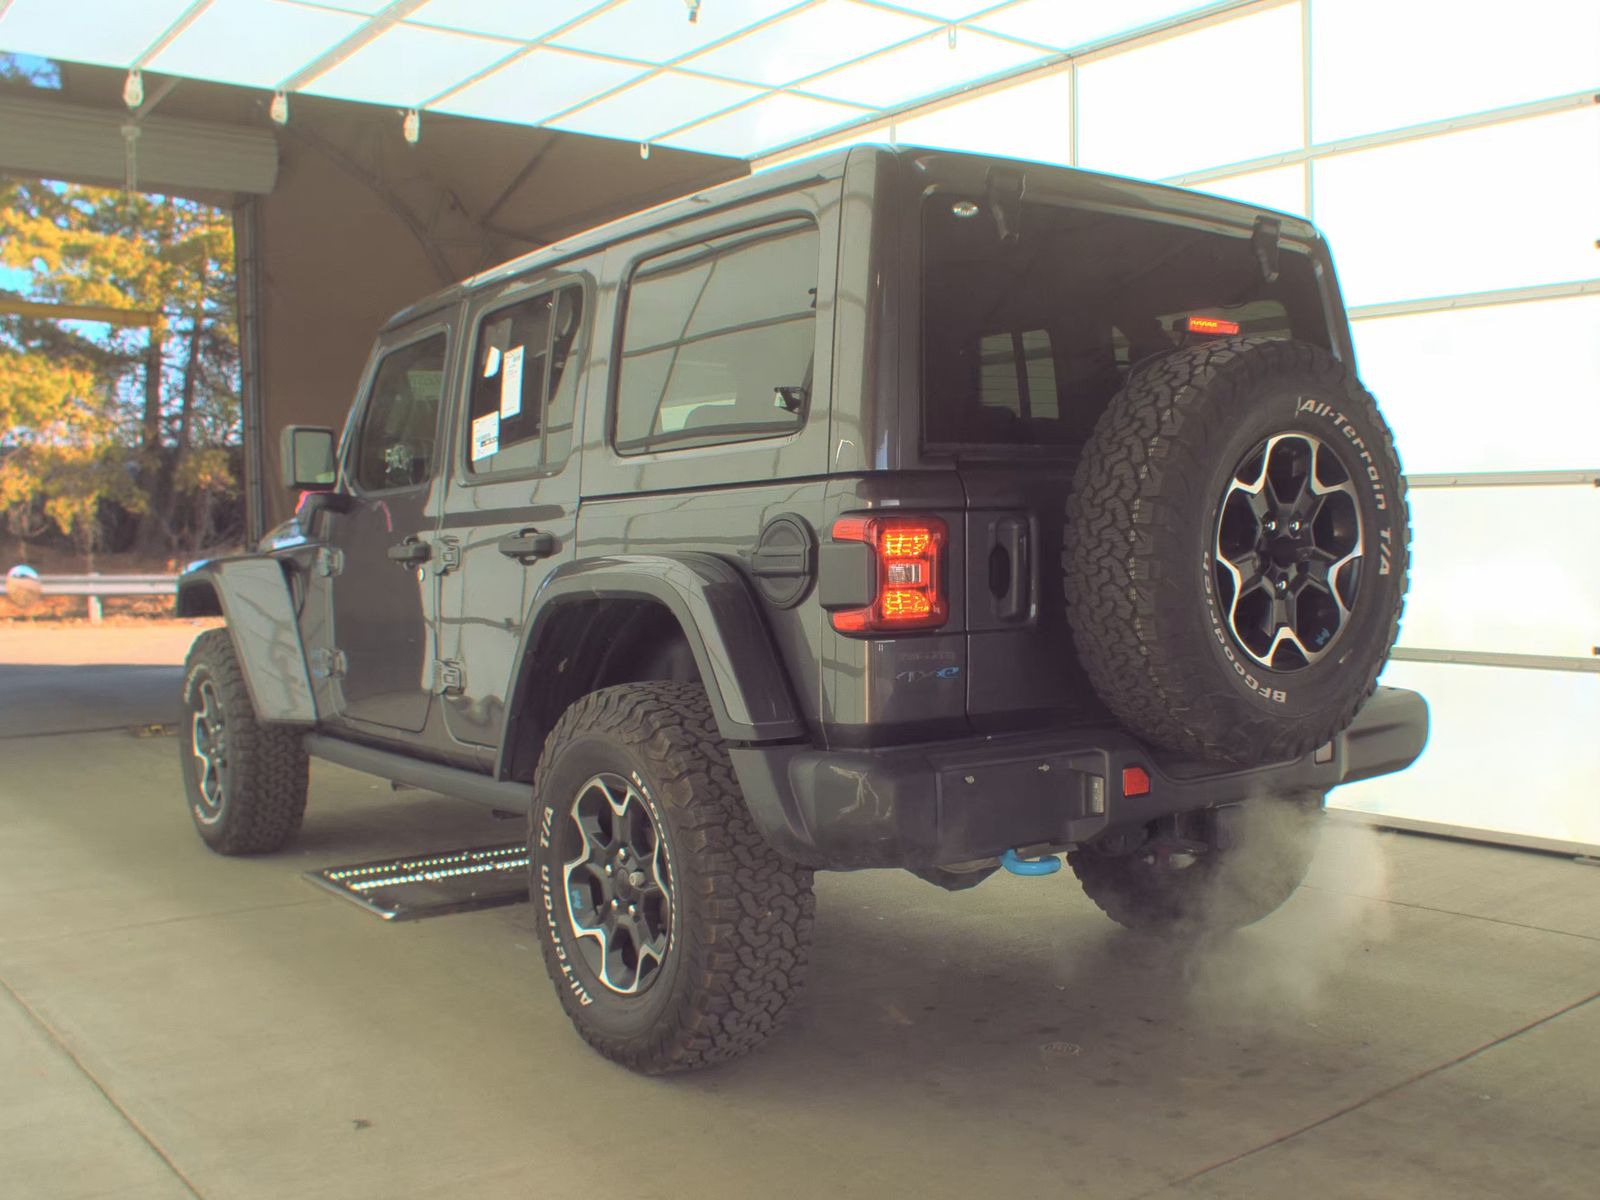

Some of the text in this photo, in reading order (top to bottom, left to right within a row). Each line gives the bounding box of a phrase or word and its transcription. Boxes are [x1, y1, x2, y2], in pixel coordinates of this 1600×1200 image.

[1299, 398, 1392, 576] All-Terrain T/A
[1203, 550, 1287, 703] BFGoodrich
[539, 806, 593, 1006] All-Terrain T/A
